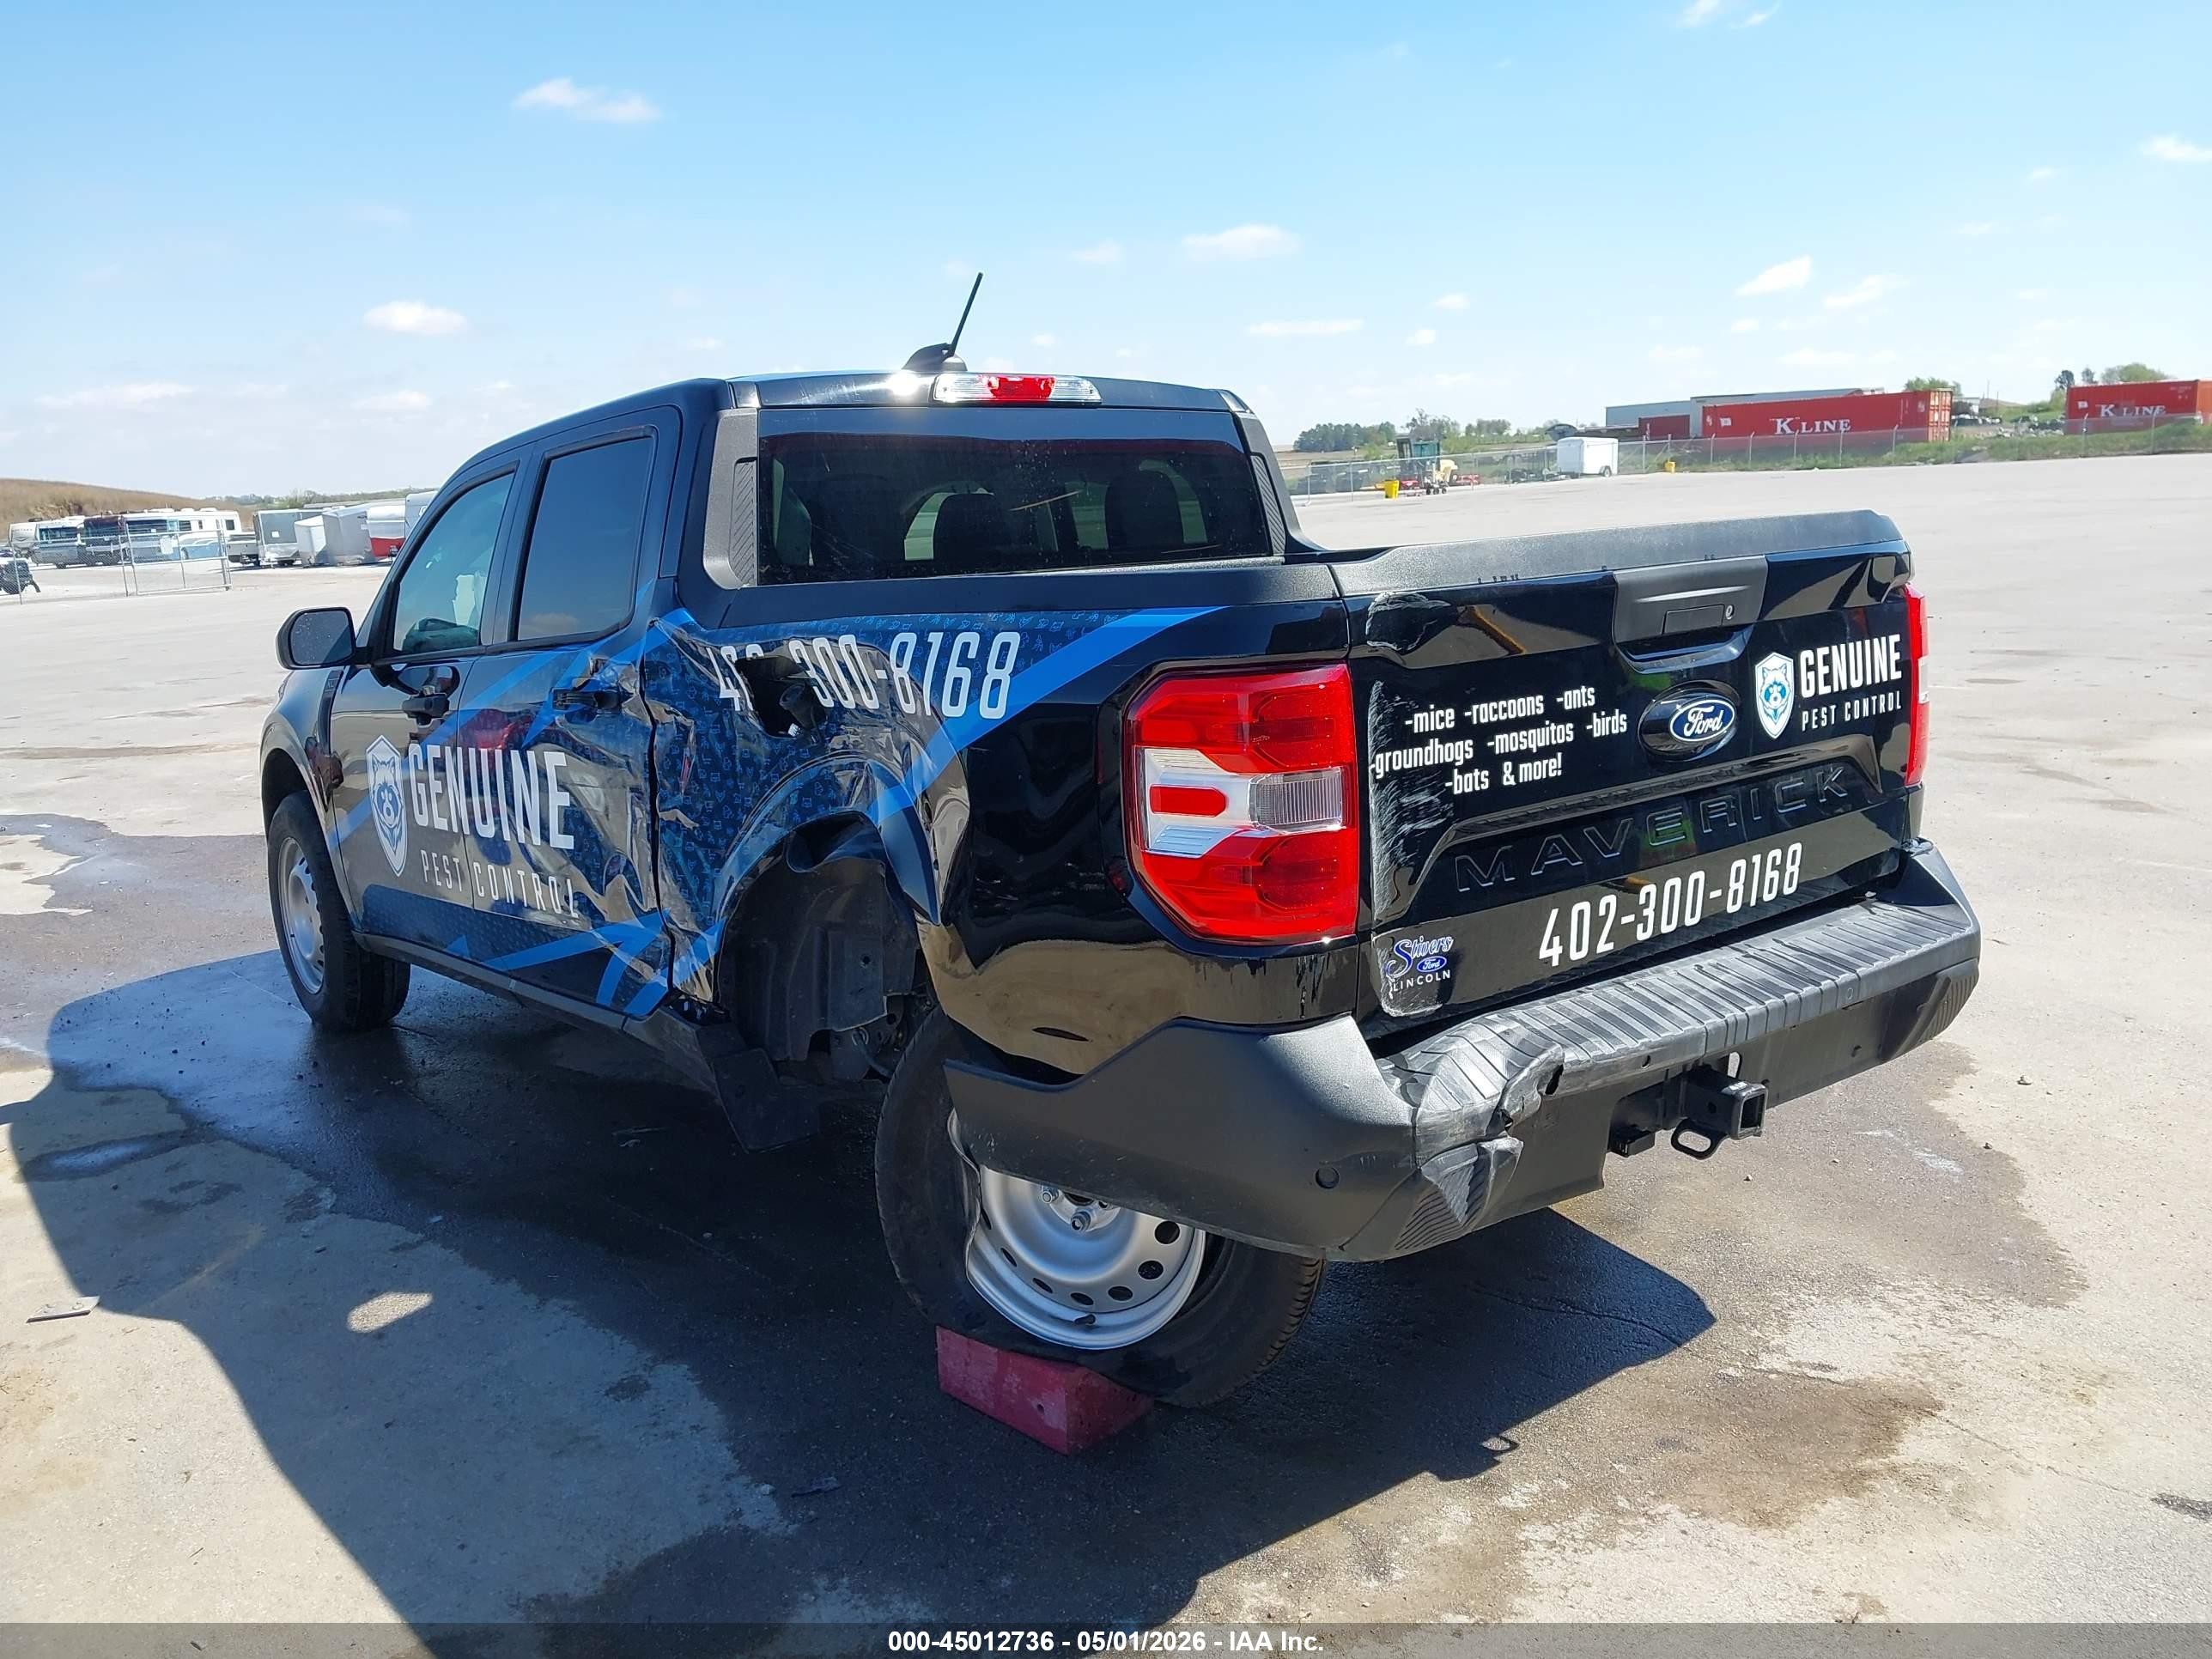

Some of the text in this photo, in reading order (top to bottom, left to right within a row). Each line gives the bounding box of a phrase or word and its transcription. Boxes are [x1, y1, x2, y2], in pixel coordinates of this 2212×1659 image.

[1801, 418, 1850, 433] LINE
[2124, 405, 2166, 416] LINE
[1800, 634, 1902, 698] GENUINE
[1405, 685, 1595, 733] -mice -raccoons -ants
[1487, 720, 1574, 755] -mosquitos
[1586, 708, 1627, 738] -birds
[1683, 705, 1724, 737] Ford
[1802, 690, 1902, 732] PEST CONTROL
[1445, 751, 1562, 795] -bats & more!
[408, 744, 574, 849] GENUINE
[1455, 766, 1848, 892] MAVERICK
[421, 849, 579, 918] PEST CONTROL
[1539, 842, 1802, 968] 402-300-8168
[1393, 969, 1451, 992] LINCOLN
[1423, 958, 1441, 970] Ford
